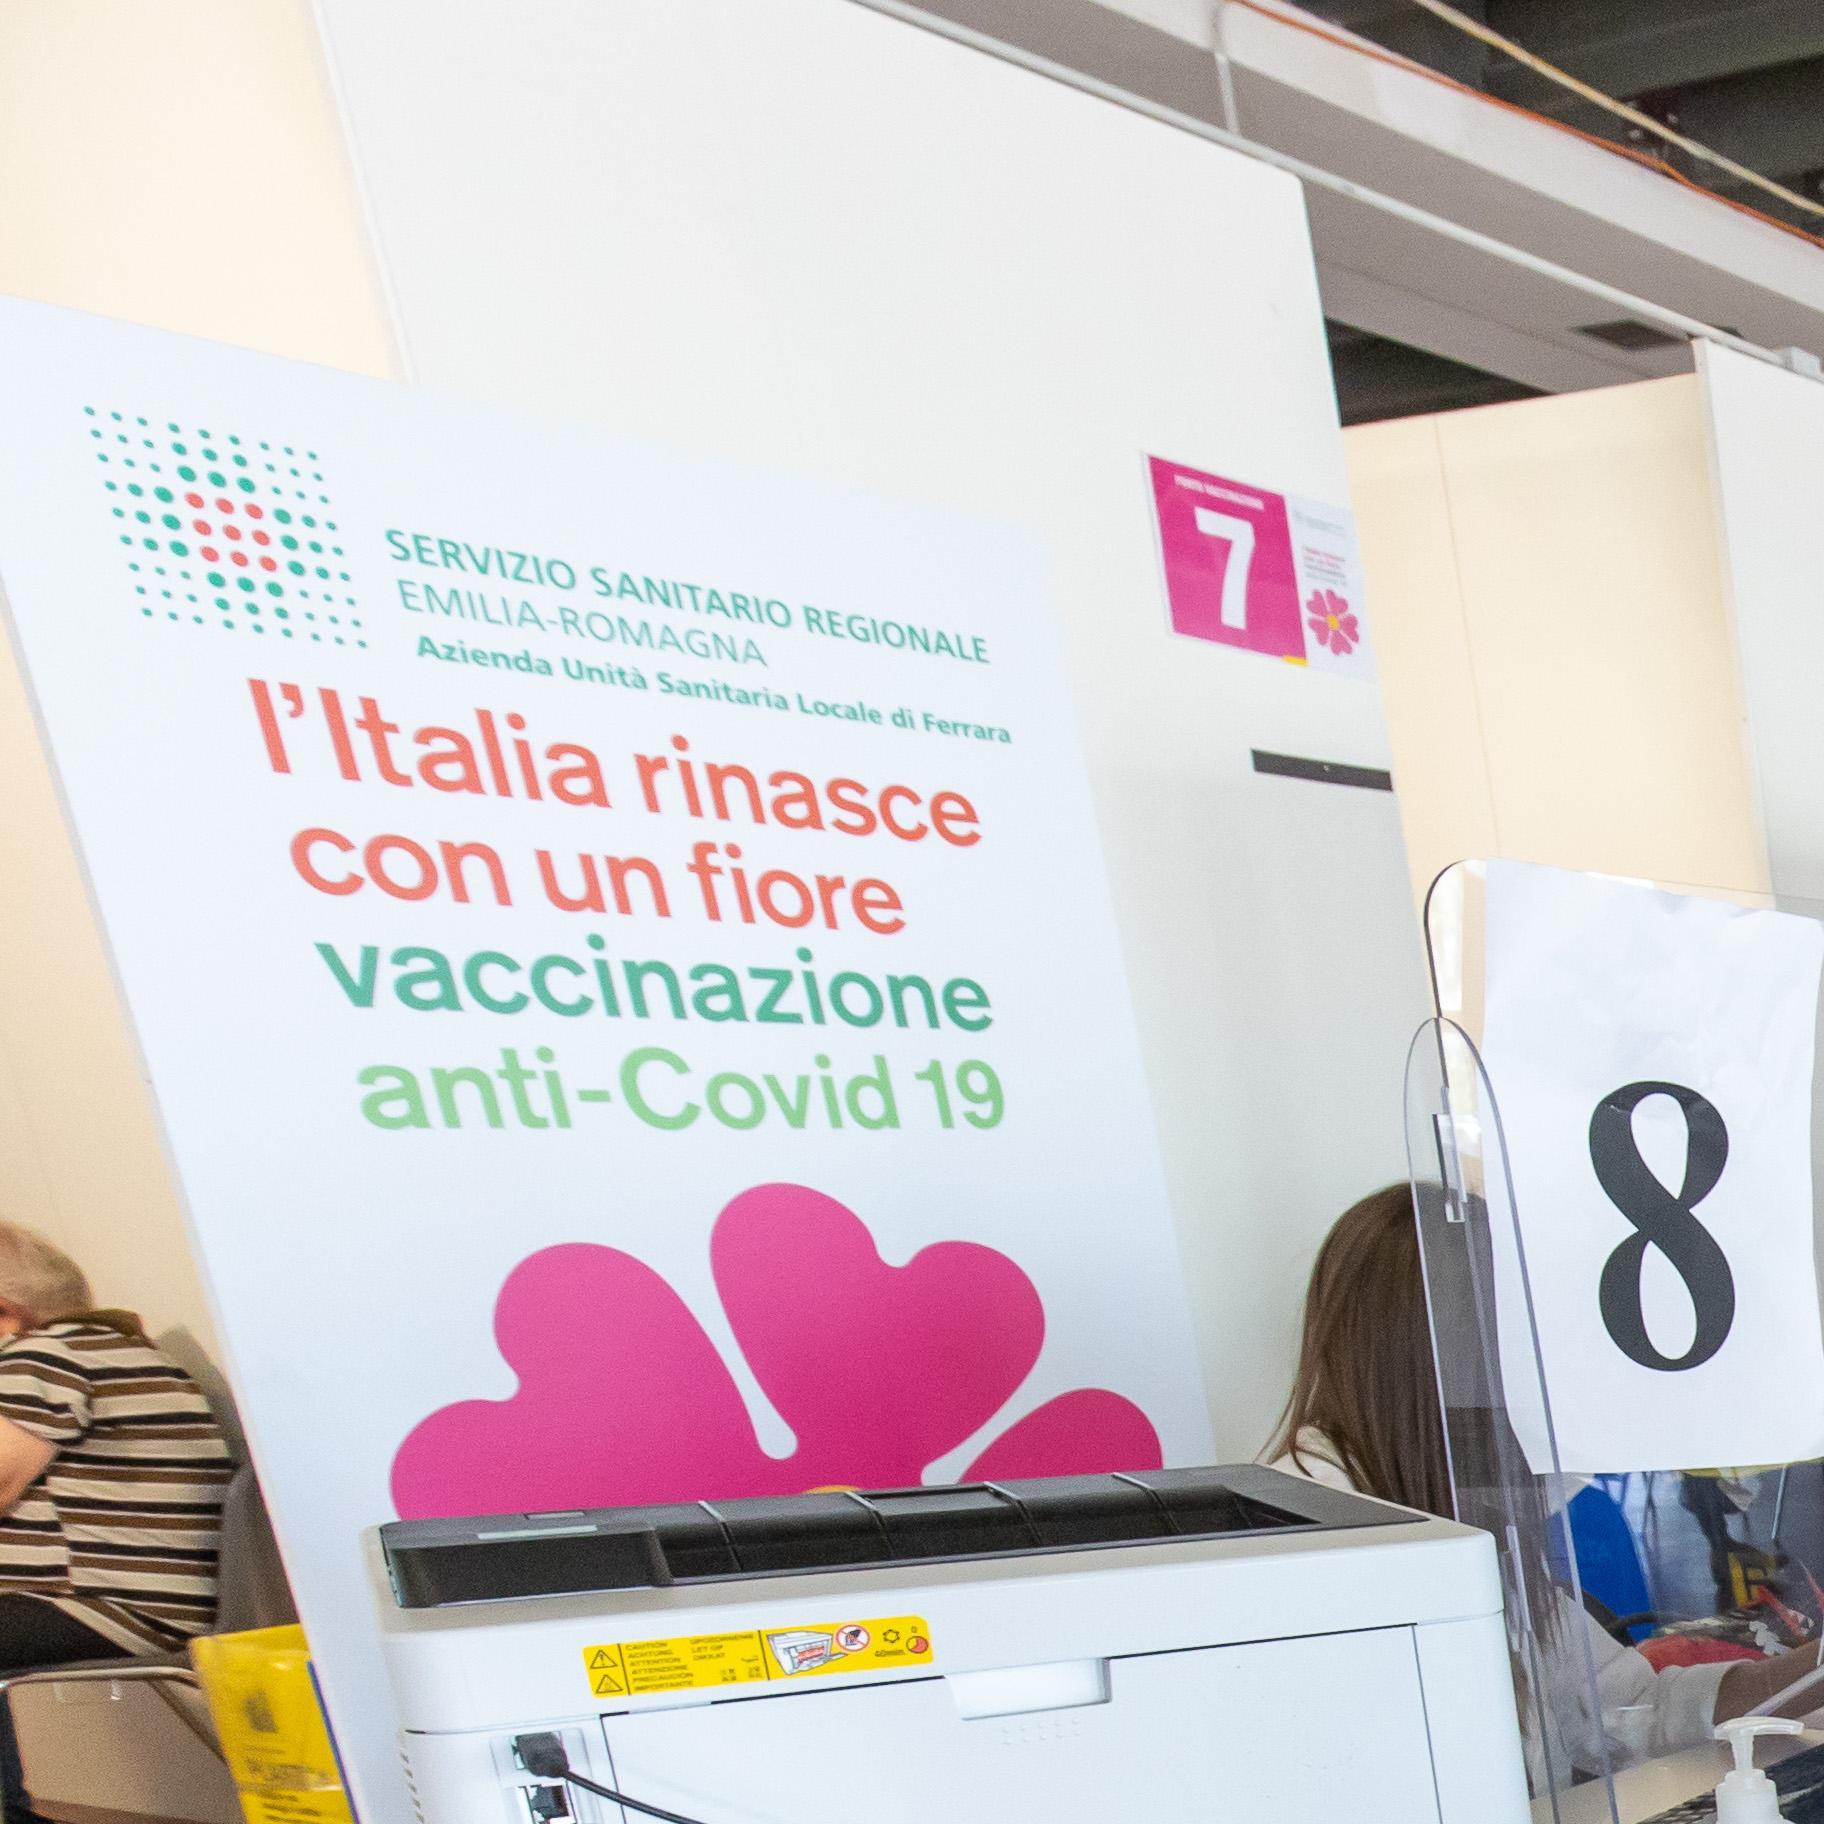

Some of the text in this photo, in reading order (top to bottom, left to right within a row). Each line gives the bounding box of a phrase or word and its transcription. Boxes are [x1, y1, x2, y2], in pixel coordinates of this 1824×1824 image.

[384, 528, 992, 664] SERVIZIO SANITARIO REGIONALE
[396, 578, 769, 668] EMILIA-ROMAGNA
[1193, 505, 1257, 631] 7
[416, 634, 1013, 744] Azienda Unità Sanitaria Locale di Ferrara
[245, 677, 983, 848] l'Italia rinasce
[289, 827, 907, 935] con un fiore
[313, 933, 995, 1032] vaccinazione
[355, 1045, 1006, 1132] anti-Covid 19
[1588, 1080, 1736, 1372] 8
